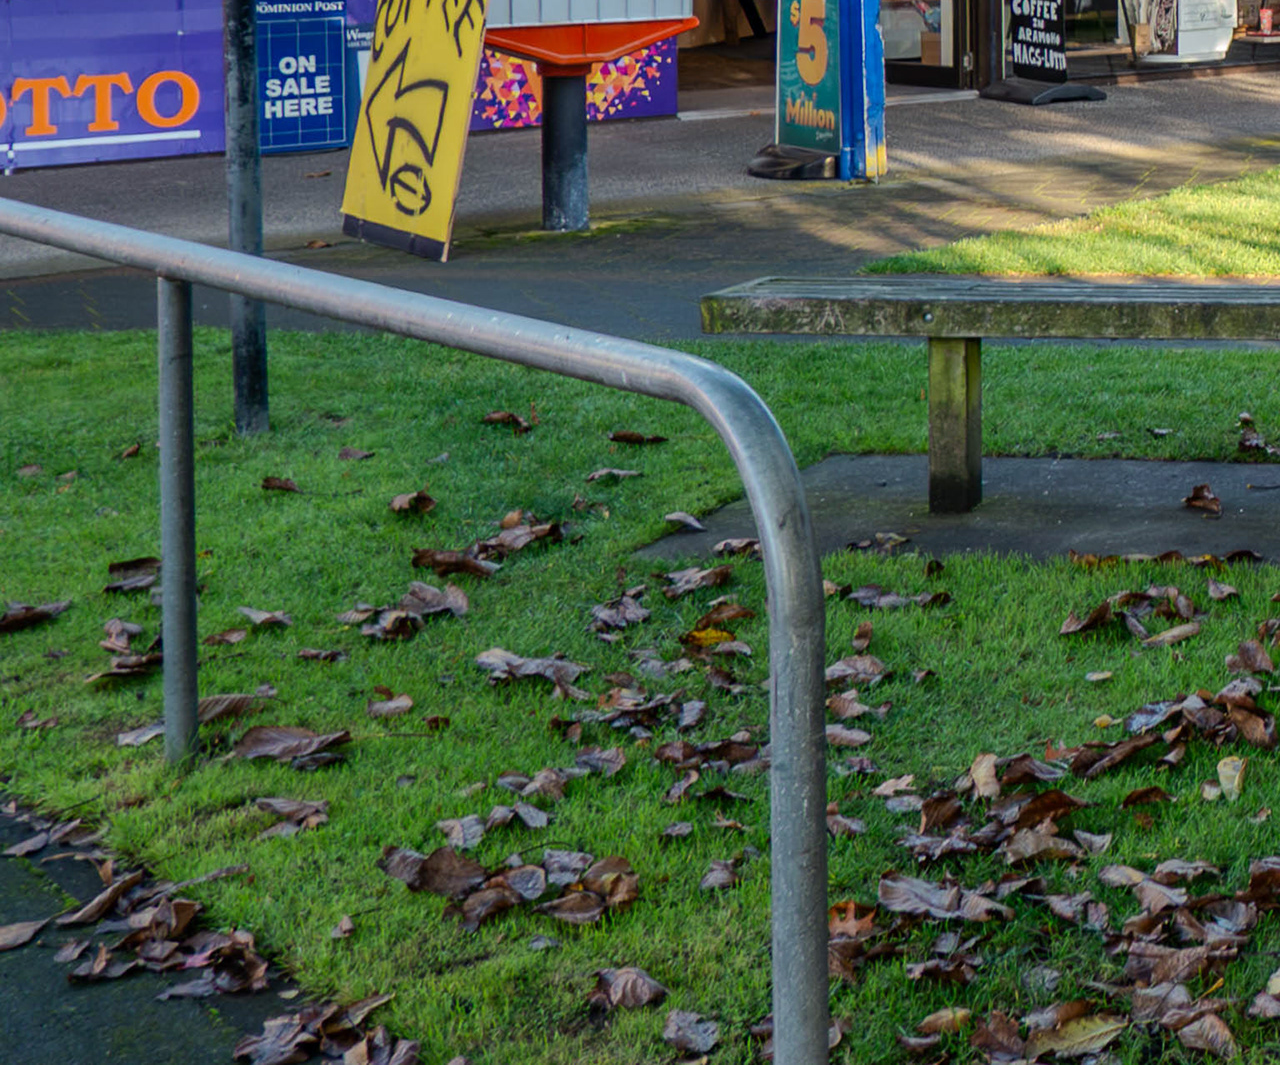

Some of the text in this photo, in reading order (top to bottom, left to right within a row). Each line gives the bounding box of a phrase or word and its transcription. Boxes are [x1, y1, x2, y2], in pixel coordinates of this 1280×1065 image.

[256, 0, 345, 14] OMINION POST
[1018, 26, 1060, 46] ARAMOHO
[279, 55, 317, 75] ON
[265, 75, 331, 97] SALE
[0, 70, 200, 136] TTO
[264, 96, 333, 119] HERE
[785, 91, 836, 130] Million
